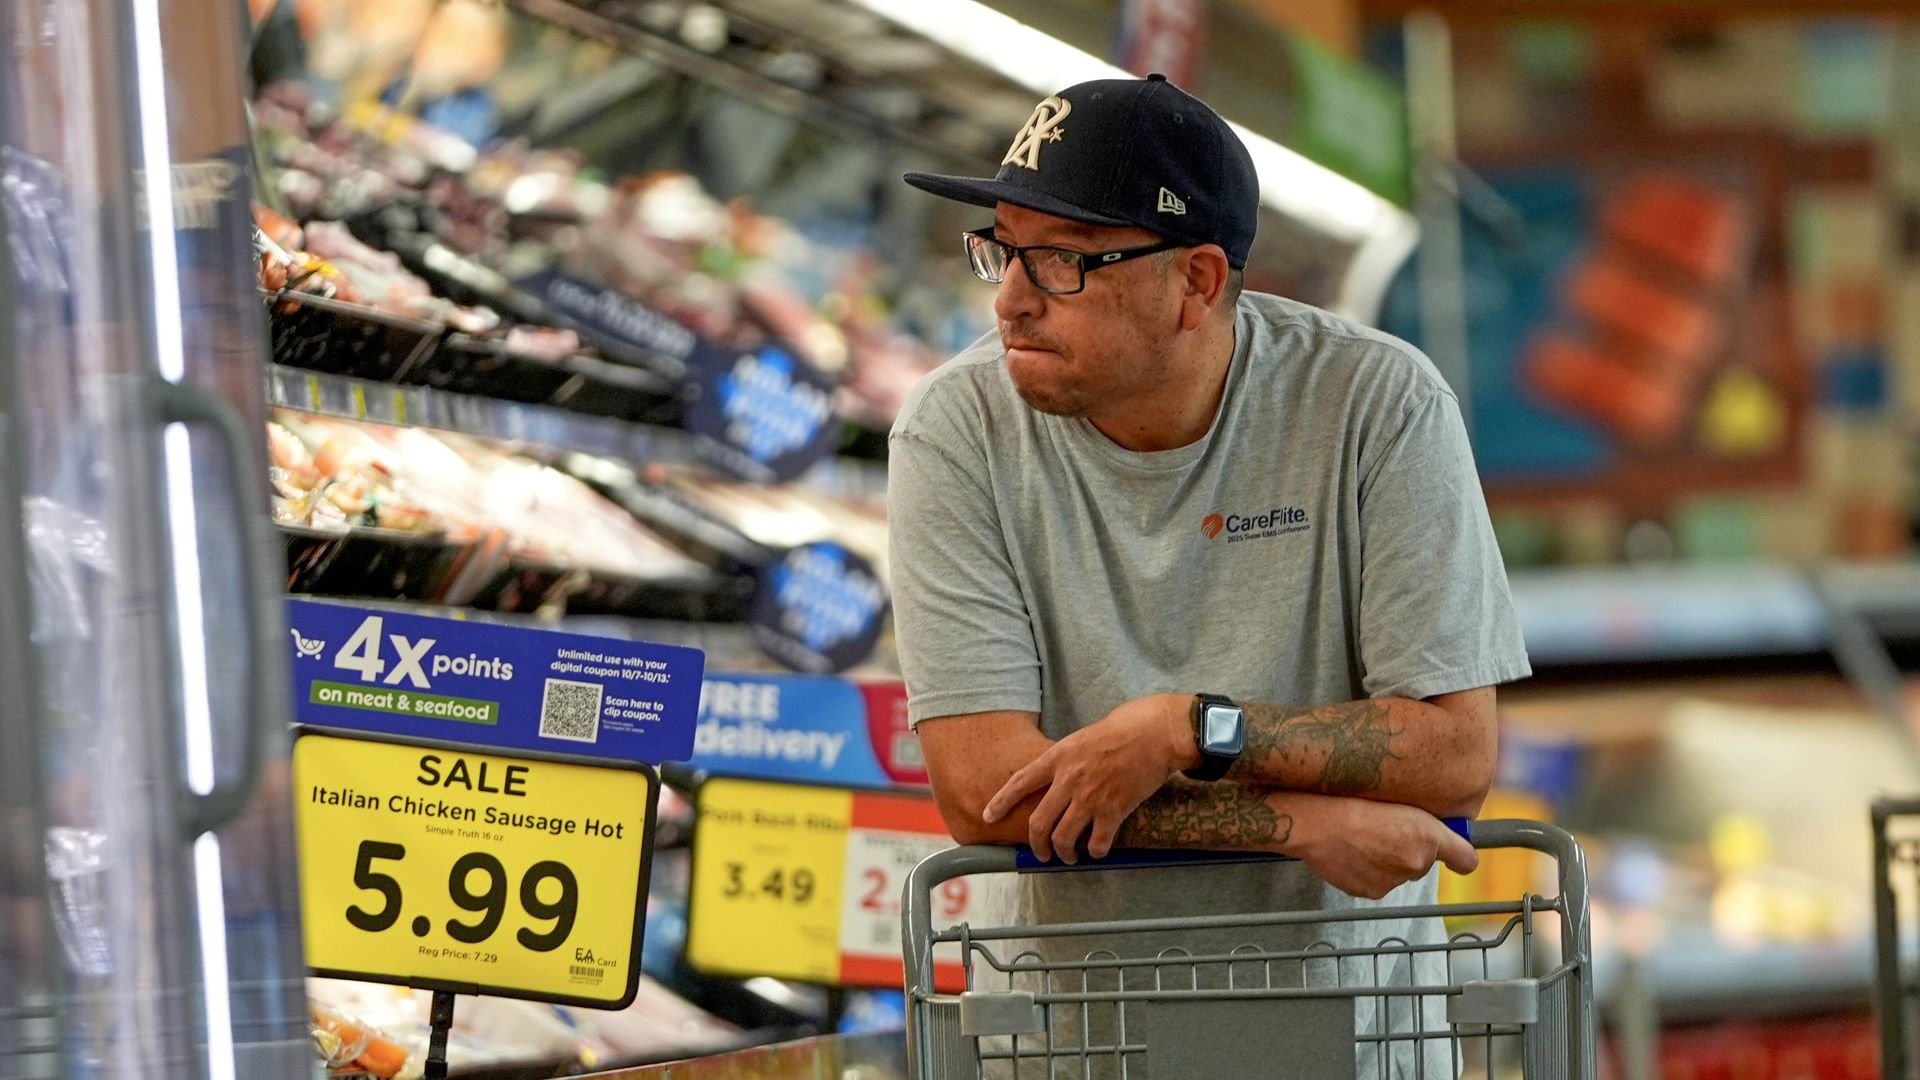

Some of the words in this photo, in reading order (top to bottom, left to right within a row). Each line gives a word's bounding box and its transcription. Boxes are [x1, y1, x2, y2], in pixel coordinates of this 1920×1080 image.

[432, 653, 514, 681] points
[551, 661, 582, 674] digital
[584, 667, 619, 679] coupon
[558, 649, 603, 663] Unlimited
[605, 655, 621, 665] use
[623, 657, 643, 668] with
[645, 662, 668, 672] your
[319, 688, 342, 701] on
[347, 691, 393, 709] meat
[397, 695, 410, 711] &
[415, 700, 490, 721] seafood
[604, 706, 621, 718] clip
[622, 710, 661, 722] coupon.
[606, 696, 629, 708] Scan
[631, 698, 652, 710] here
[654, 701, 664, 712] to
[418, 755, 529, 797] SALE
[312, 786, 380, 810] Italian
[388, 796, 476, 822] Chicken
[484, 807, 576, 835] Sausage
[585, 819, 624, 839] Hot
[425, 825, 454, 836] Simple
[457, 829, 479, 839] Truth
[721, 862, 815, 904] 3.49
[860, 867, 969, 918] 2.9
[346, 839, 578, 952] 5.99
[418, 946, 438, 957] Reg
[442, 948, 471, 960] Price:
[474, 952, 498, 963] 7.29
[575, 948, 594, 961] EA
[597, 958, 617, 968] Card
